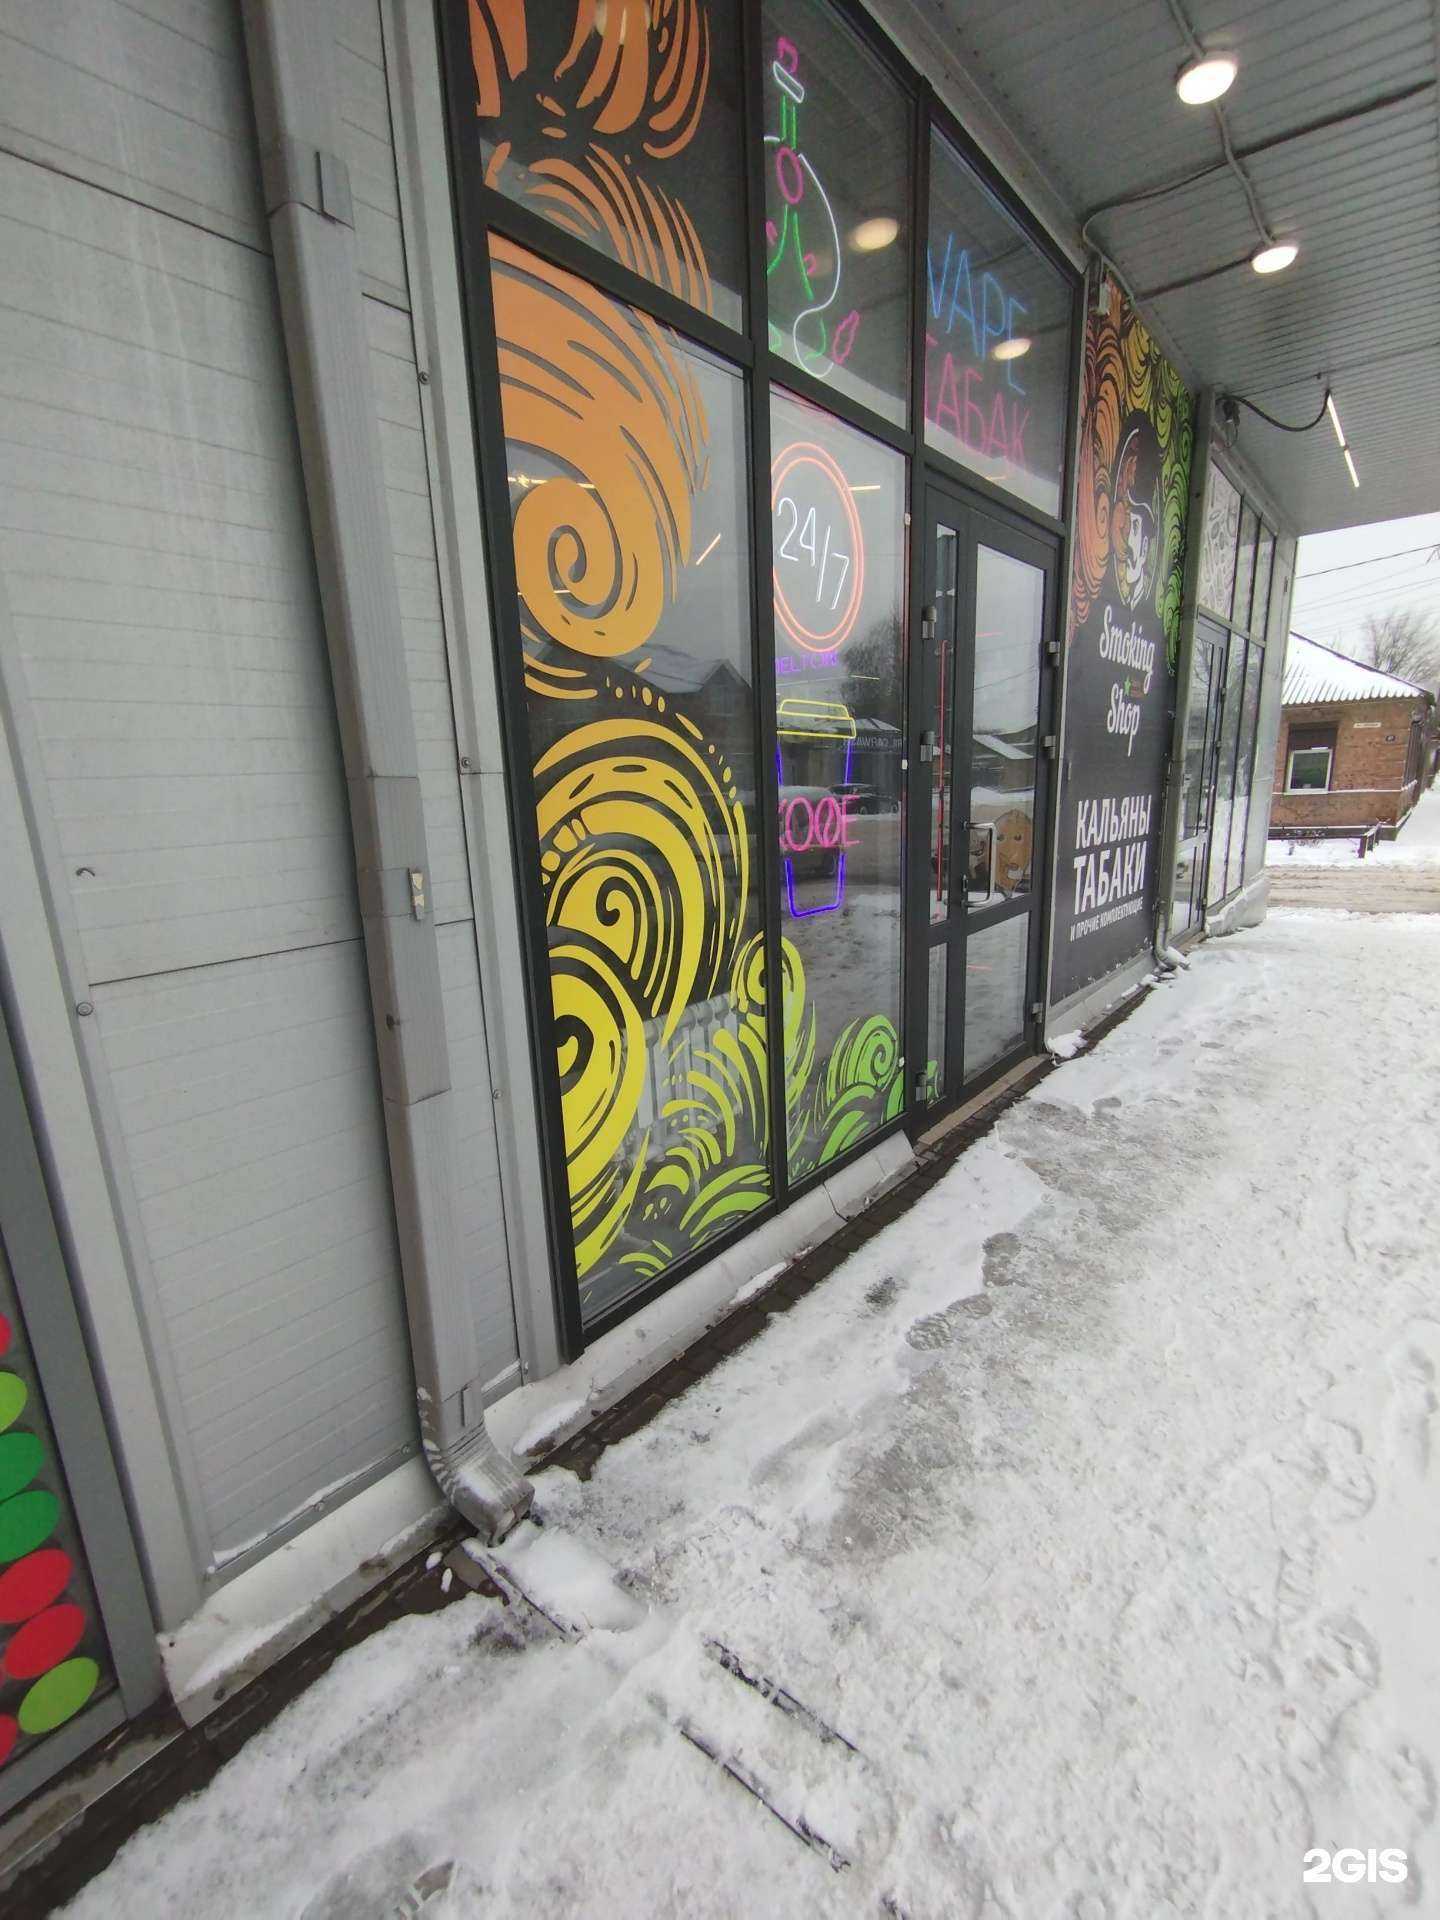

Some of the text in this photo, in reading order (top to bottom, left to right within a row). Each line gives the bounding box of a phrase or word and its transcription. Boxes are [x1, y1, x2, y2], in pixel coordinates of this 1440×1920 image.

[925, 232, 1028, 396] VAPE
[777, 496, 850, 610] 24/7
[1100, 604, 1156, 694] Smoking
[1107, 683, 1140, 757] Shop
[1075, 795, 1152, 849] КАЛЬЯНЫ
[1073, 841, 1147, 915] ТАБАКИ
[1070, 924, 1076, 942] И
[1076, 914, 1099, 940] ПРОЧИЕ
